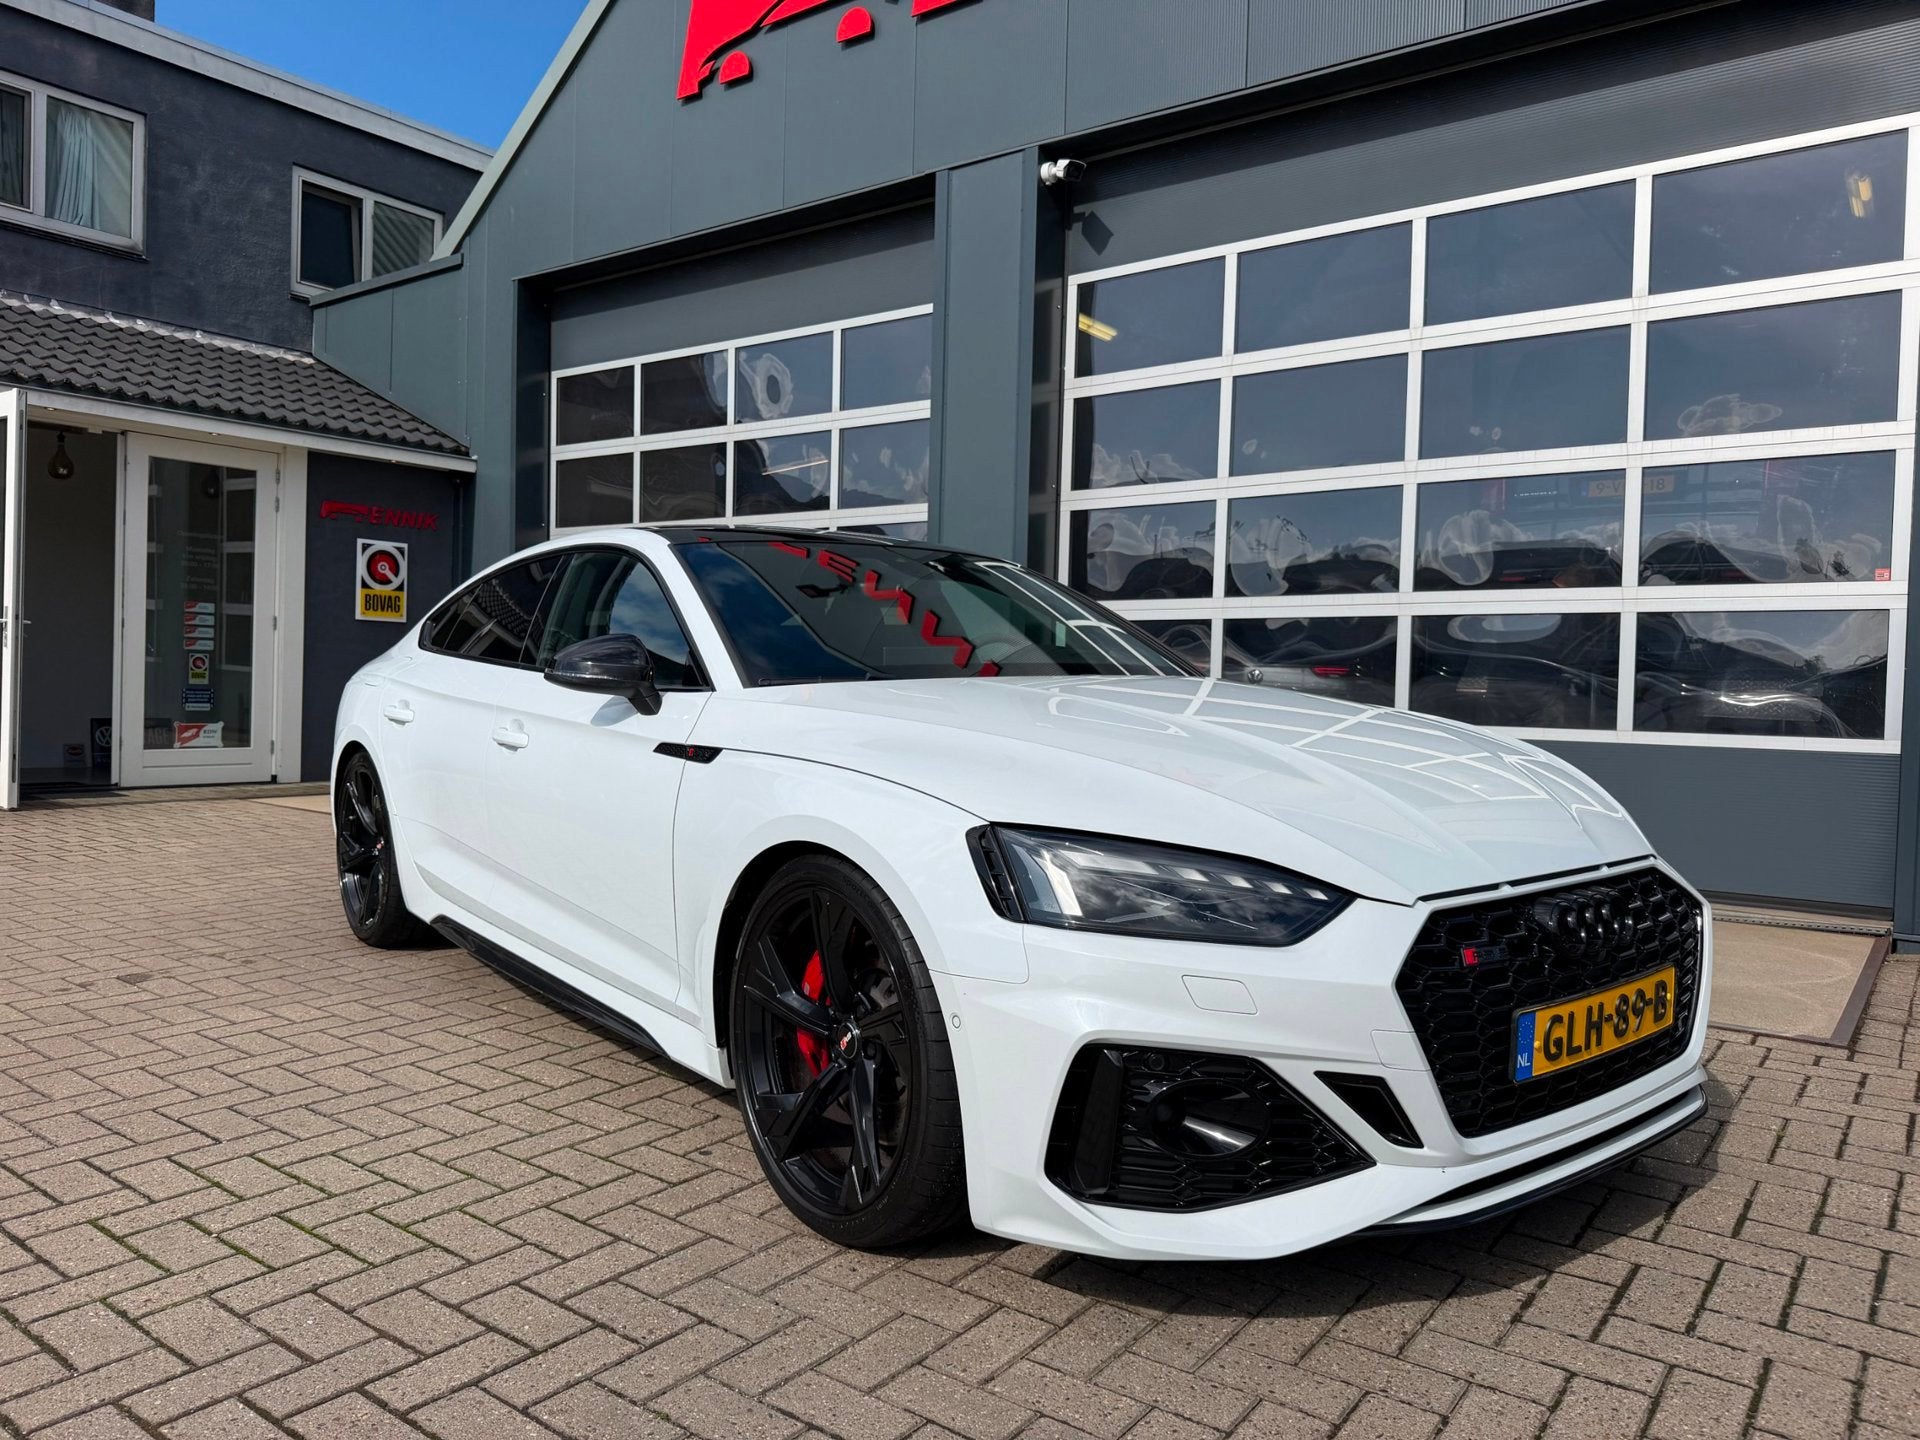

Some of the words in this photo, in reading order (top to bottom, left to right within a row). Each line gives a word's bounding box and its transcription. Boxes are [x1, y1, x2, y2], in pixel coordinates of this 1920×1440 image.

[365, 593, 401, 614] BOVAG
[1543, 979, 1668, 1063] GLH-89-B
[1517, 1053, 1531, 1069] NL
